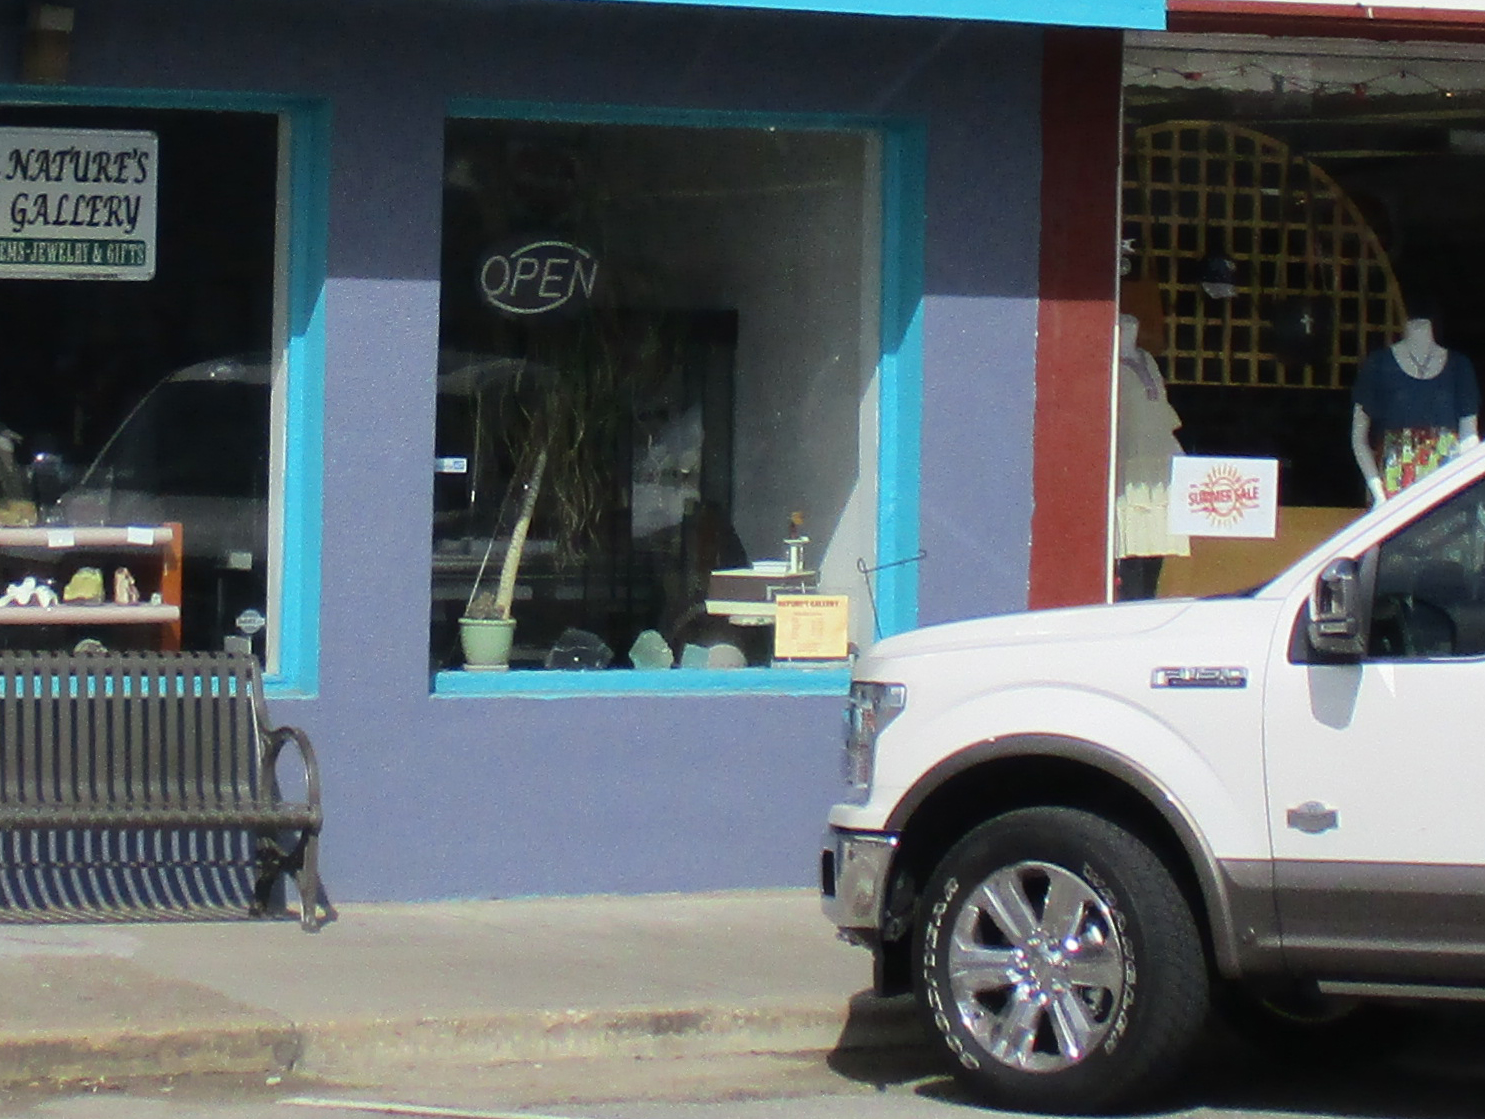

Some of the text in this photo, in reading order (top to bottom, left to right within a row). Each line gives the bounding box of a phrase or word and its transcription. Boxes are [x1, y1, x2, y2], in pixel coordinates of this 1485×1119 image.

[6, 146, 149, 184] NATURE'S
[11, 193, 141, 234] GALLERY
[92, 244, 102, 262] &
[107, 242, 145, 265] GIFTS
[481, 255, 599, 299] OPEN
[1234, 486, 1260, 501] SALE
